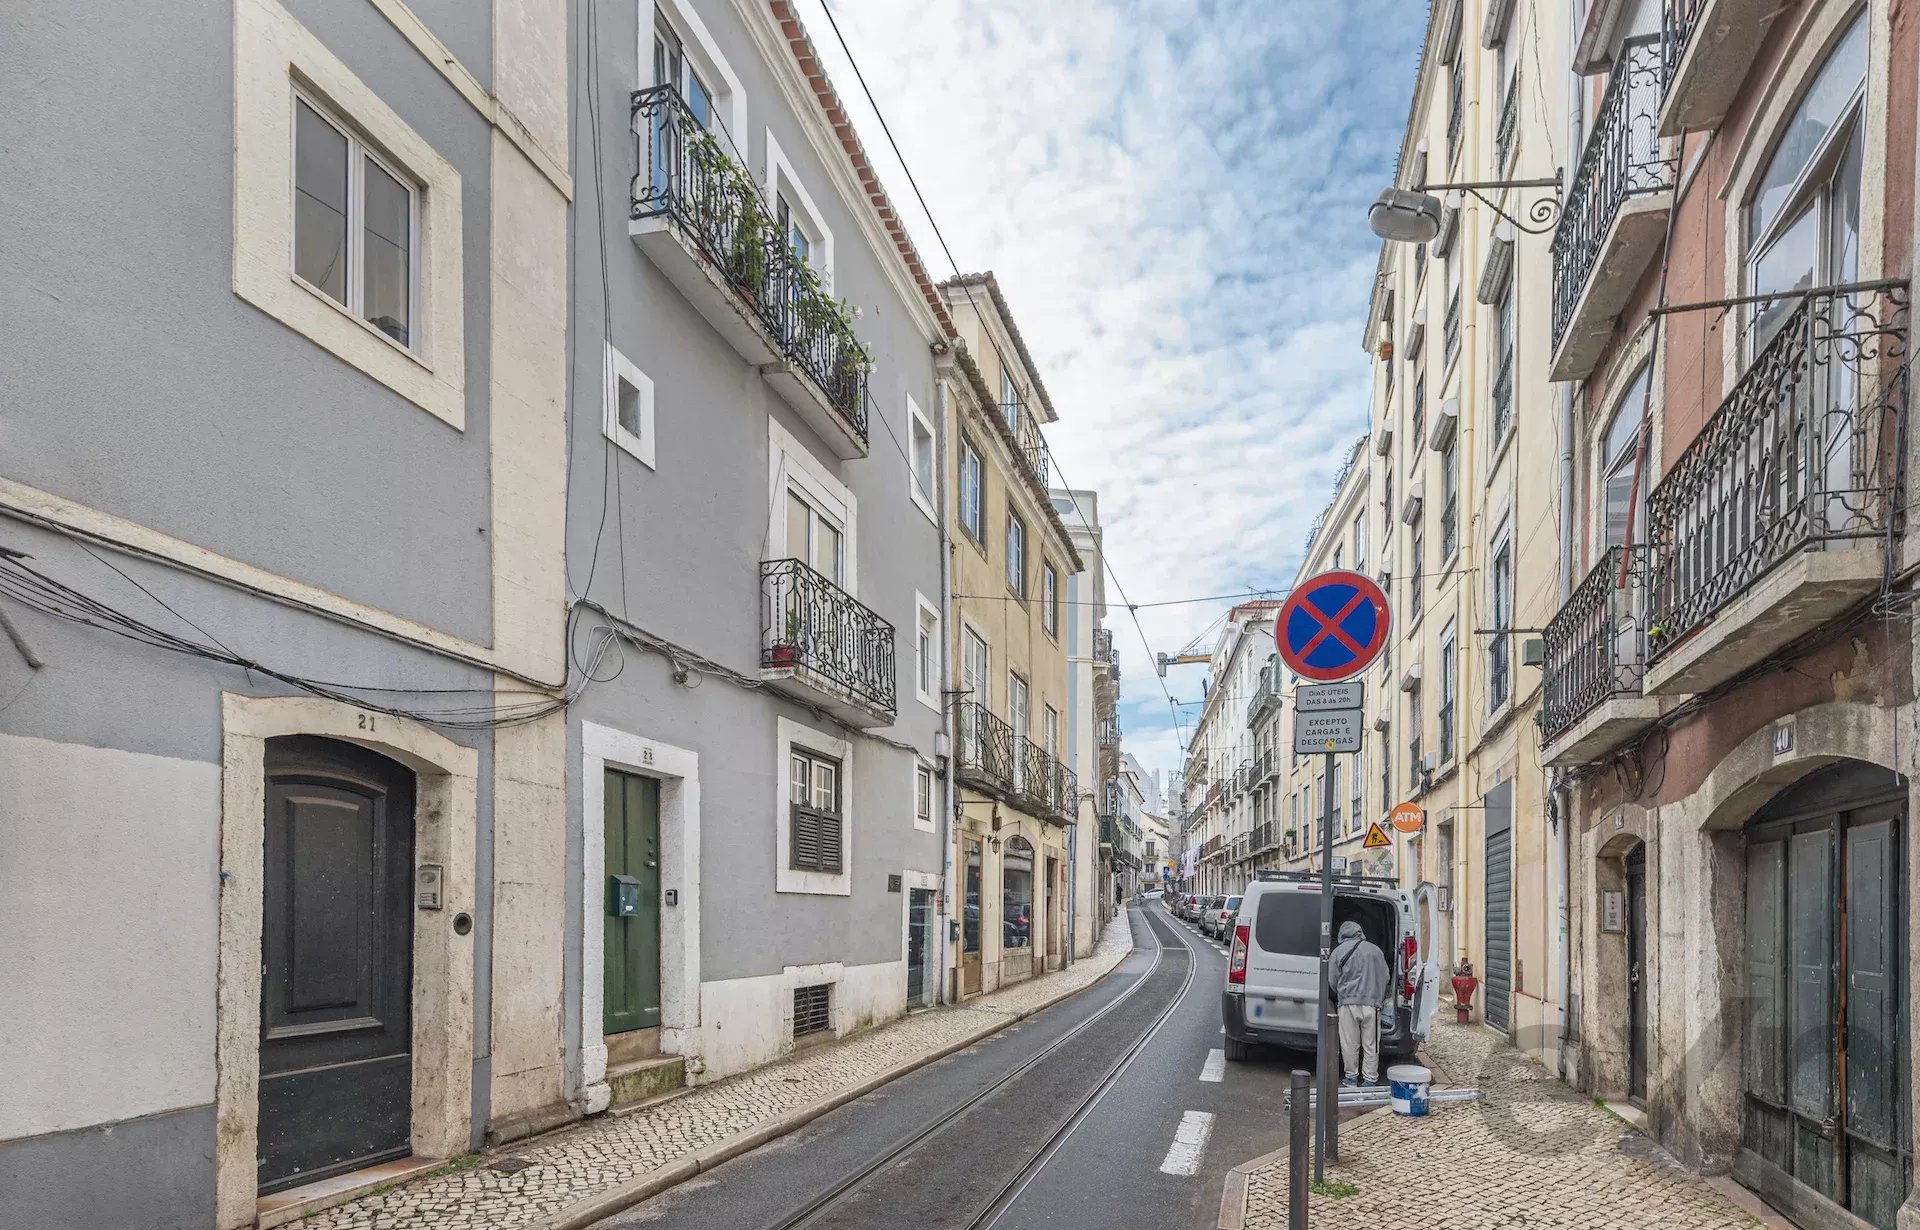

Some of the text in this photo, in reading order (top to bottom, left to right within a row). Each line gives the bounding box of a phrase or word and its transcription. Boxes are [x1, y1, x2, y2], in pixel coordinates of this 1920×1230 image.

[1308, 688, 1349, 697] DIAS ÚTEIS
[1306, 698, 1321, 706] DAS
[358, 713, 376, 732] 21
[1308, 718, 1348, 726] EXCEPTO
[1305, 727, 1351, 736] CARGAS E
[1776, 727, 1789, 751] 40
[1394, 811, 1422, 823] ATM
